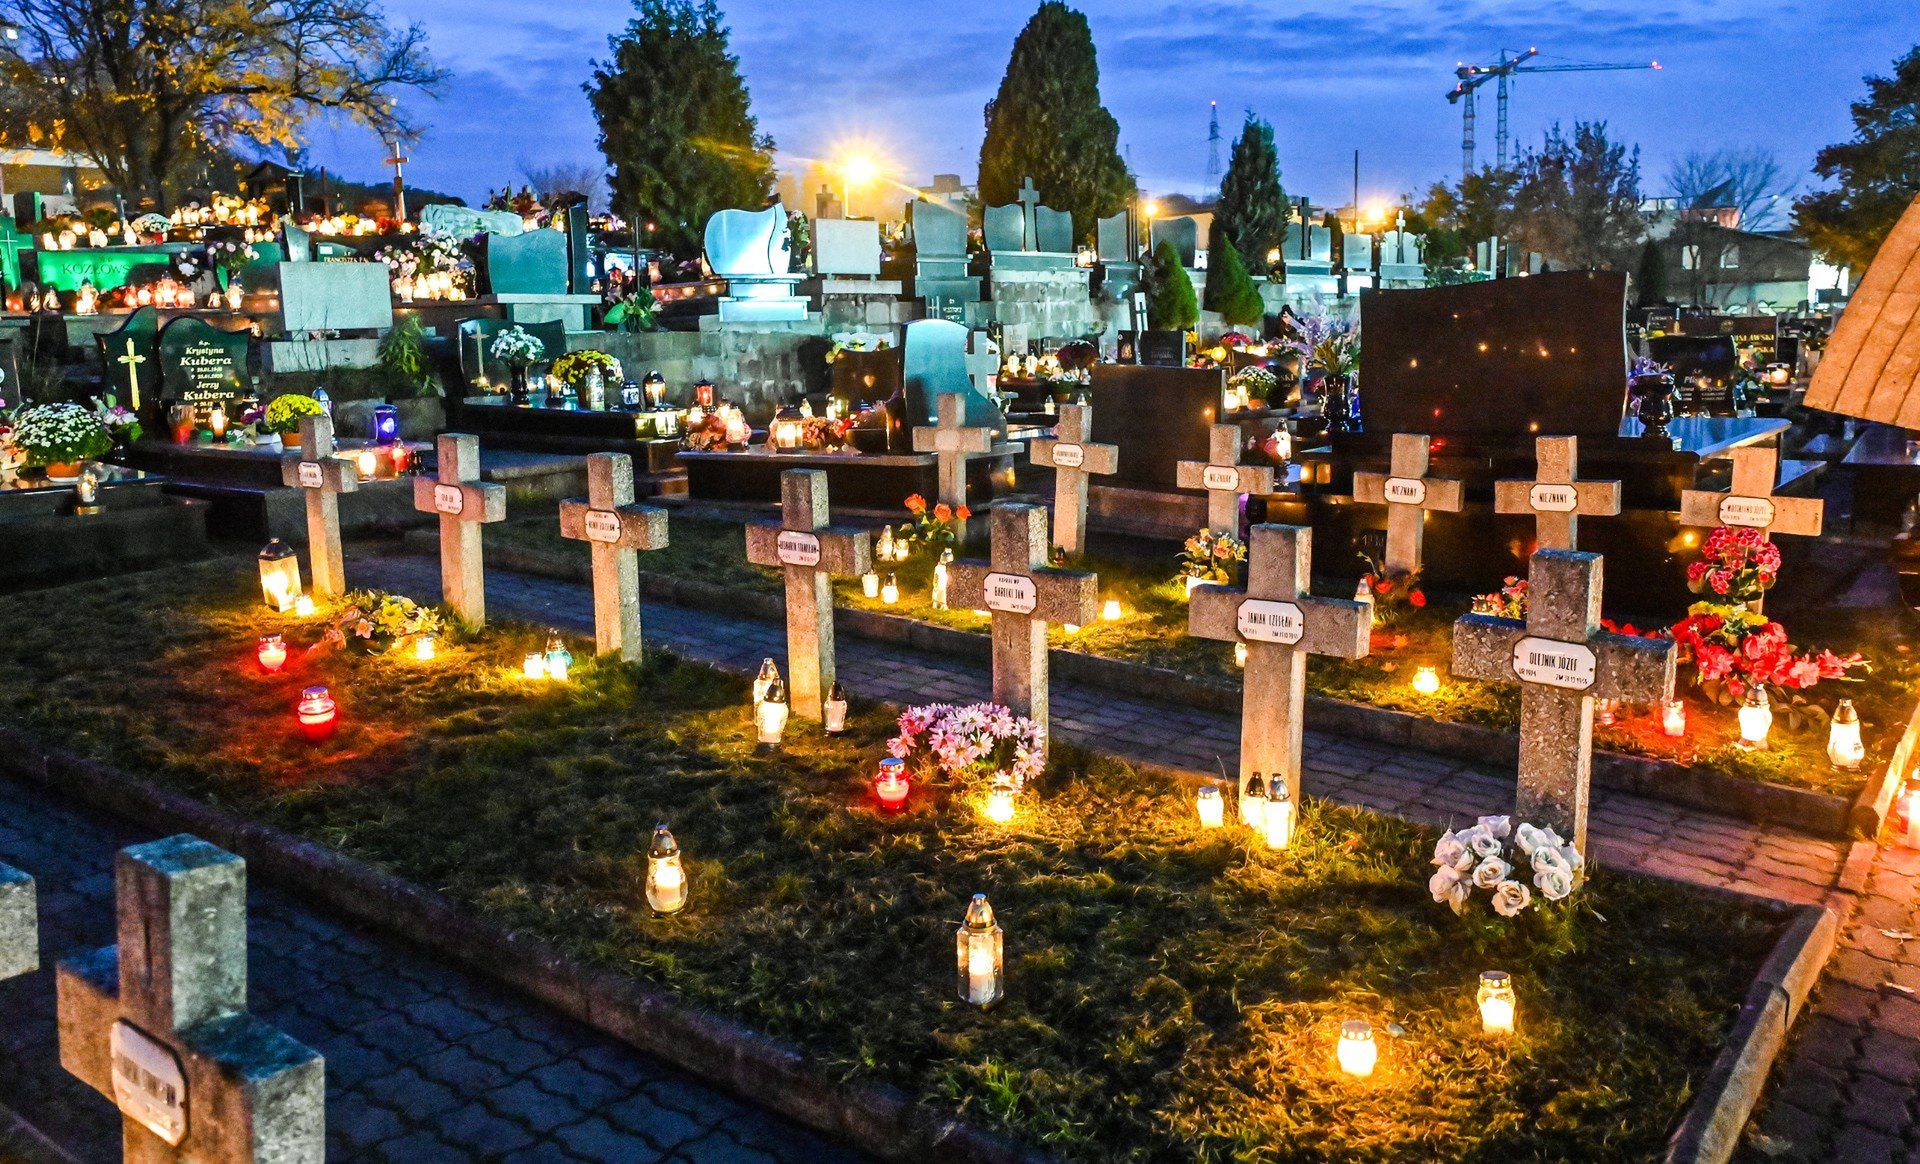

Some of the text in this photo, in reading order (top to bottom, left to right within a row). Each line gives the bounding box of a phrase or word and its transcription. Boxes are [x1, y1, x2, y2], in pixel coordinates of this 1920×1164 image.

[185, 347, 224, 356] Krystyna
[180, 357, 233, 366] Kubera
[196, 381, 220, 390] Jerzy
[183, 391, 235, 401] Kubera
[1391, 485, 1418, 497] NIEZNANY
[1539, 492, 1568, 504] NIEZNANY
[1529, 652, 1578, 671] OLEJNIK JÓZEF
